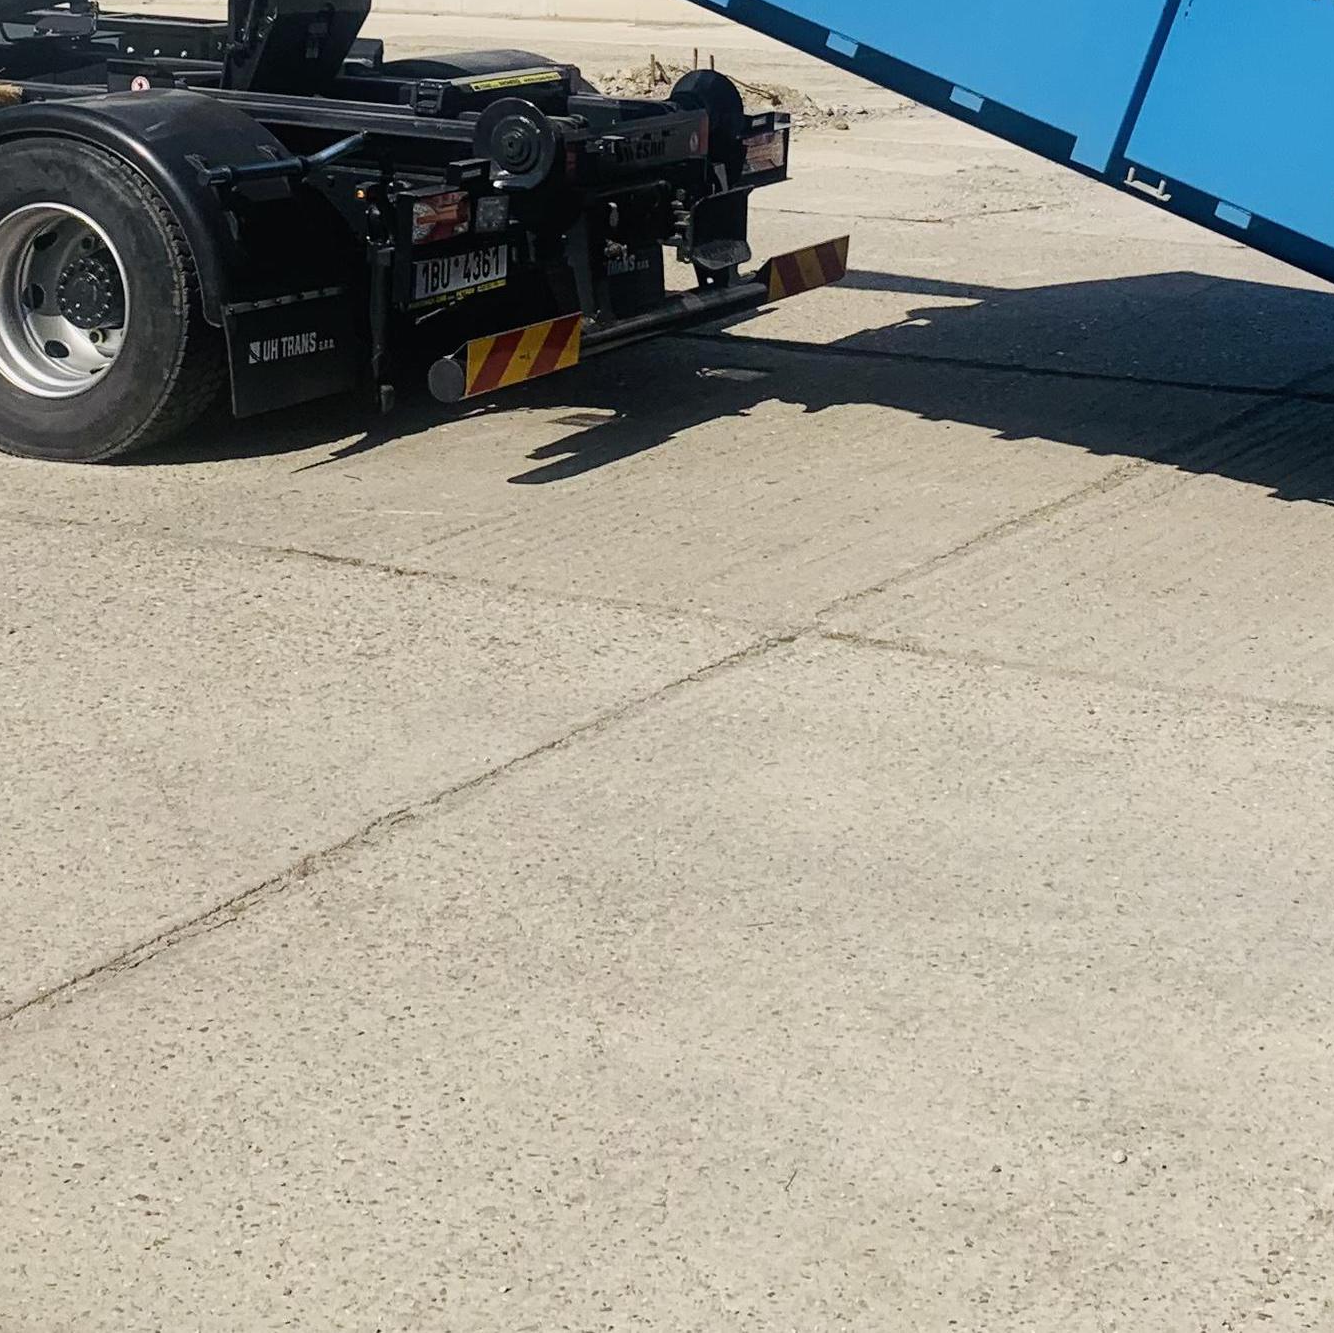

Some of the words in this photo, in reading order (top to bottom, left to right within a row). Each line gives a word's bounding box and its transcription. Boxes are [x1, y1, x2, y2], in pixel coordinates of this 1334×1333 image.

[421, 258, 451, 294] 1BU
[263, 338, 279, 361] UH
[281, 332, 317, 357] TRANS
